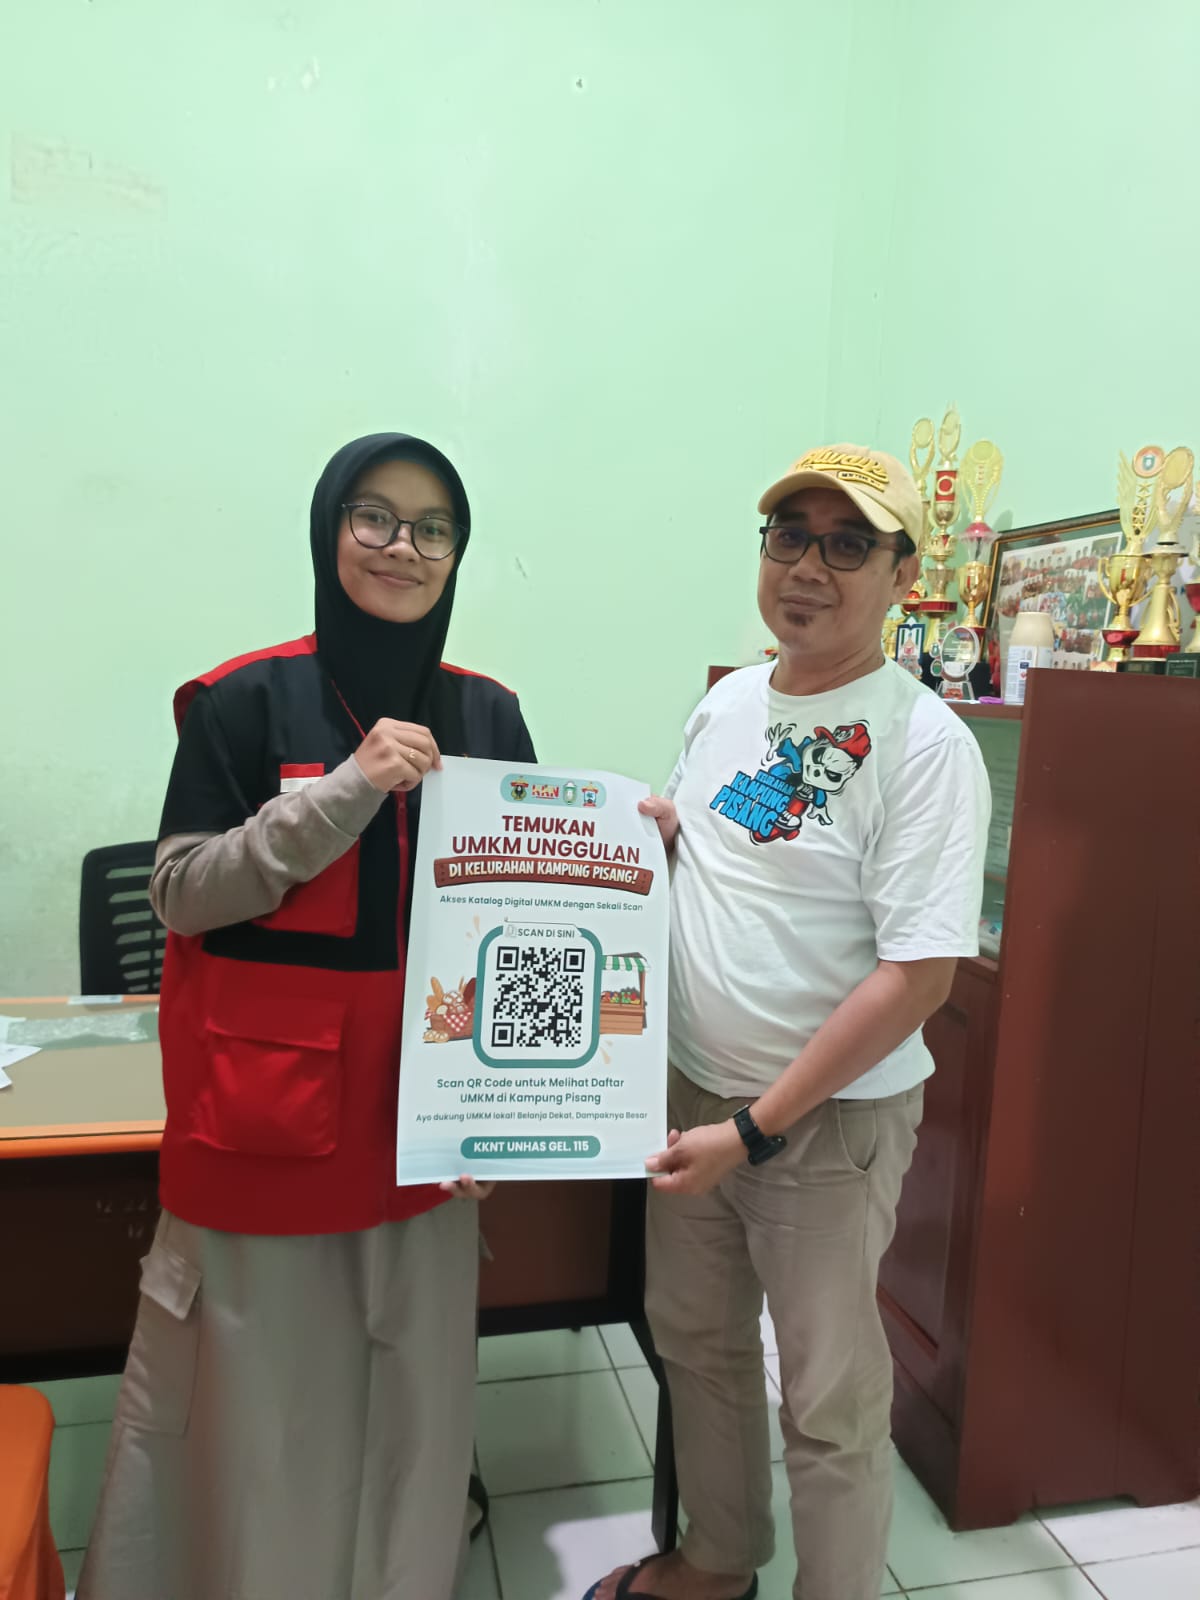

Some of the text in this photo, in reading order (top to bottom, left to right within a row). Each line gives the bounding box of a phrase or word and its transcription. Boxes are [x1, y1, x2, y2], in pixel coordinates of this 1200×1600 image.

[729, 771, 790, 813] KAMPUNG
[709, 785, 778, 838] PISANG
[501, 815, 595, 837] TEMUKAN
[452, 836, 640, 864] UMKM UNGGULAN
[448, 860, 639, 884] DI KELURAHAN KAMPUNG PISANG!
[440, 895, 643, 911] Akses Katalog Digital UMKM dengan Sekali Scan
[518, 928, 575, 938] SCAN DI SINI
[437, 1077, 625, 1088] Scan QR Code untuk Melihat Daftar
[460, 1092, 601, 1105] UMKM di Kampung Pisang
[416, 1114, 432, 1123] Ayo
[433, 1112, 465, 1122] dukung
[466, 1111, 492, 1119] UMKM
[493, 1111, 516, 1119] lokal!
[517, 1111, 547, 1121] Belanja
[576, 1111, 625, 1120] Dampaknya
[626, 1111, 648, 1119] Besar
[473, 1141, 589, 1152] KKNT UNHAS GEL. 115
